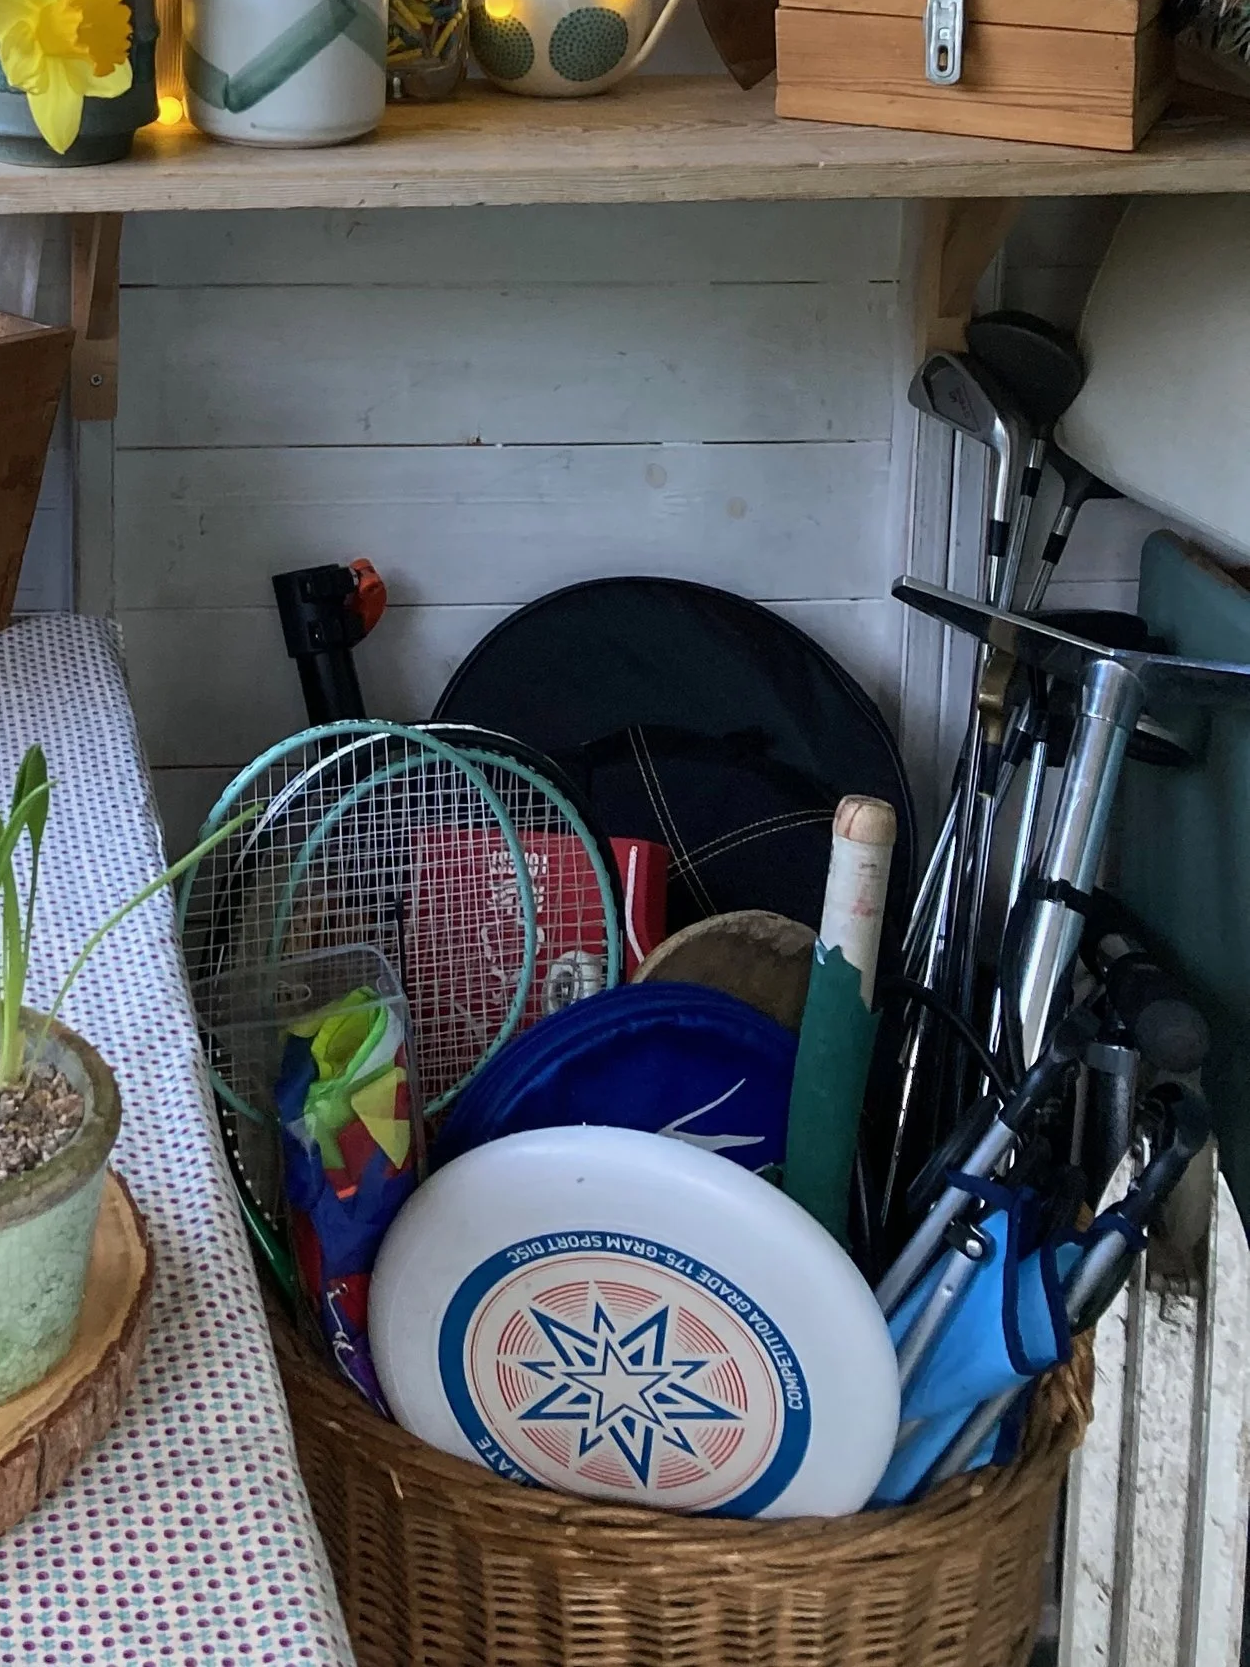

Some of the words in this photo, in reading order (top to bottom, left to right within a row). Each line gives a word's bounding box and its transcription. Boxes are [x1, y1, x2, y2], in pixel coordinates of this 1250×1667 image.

[548, 1235, 603, 1251] SPORT
[607, 1235, 694, 1274] 175-GRAM
[696, 1268, 751, 1313] GRADE
